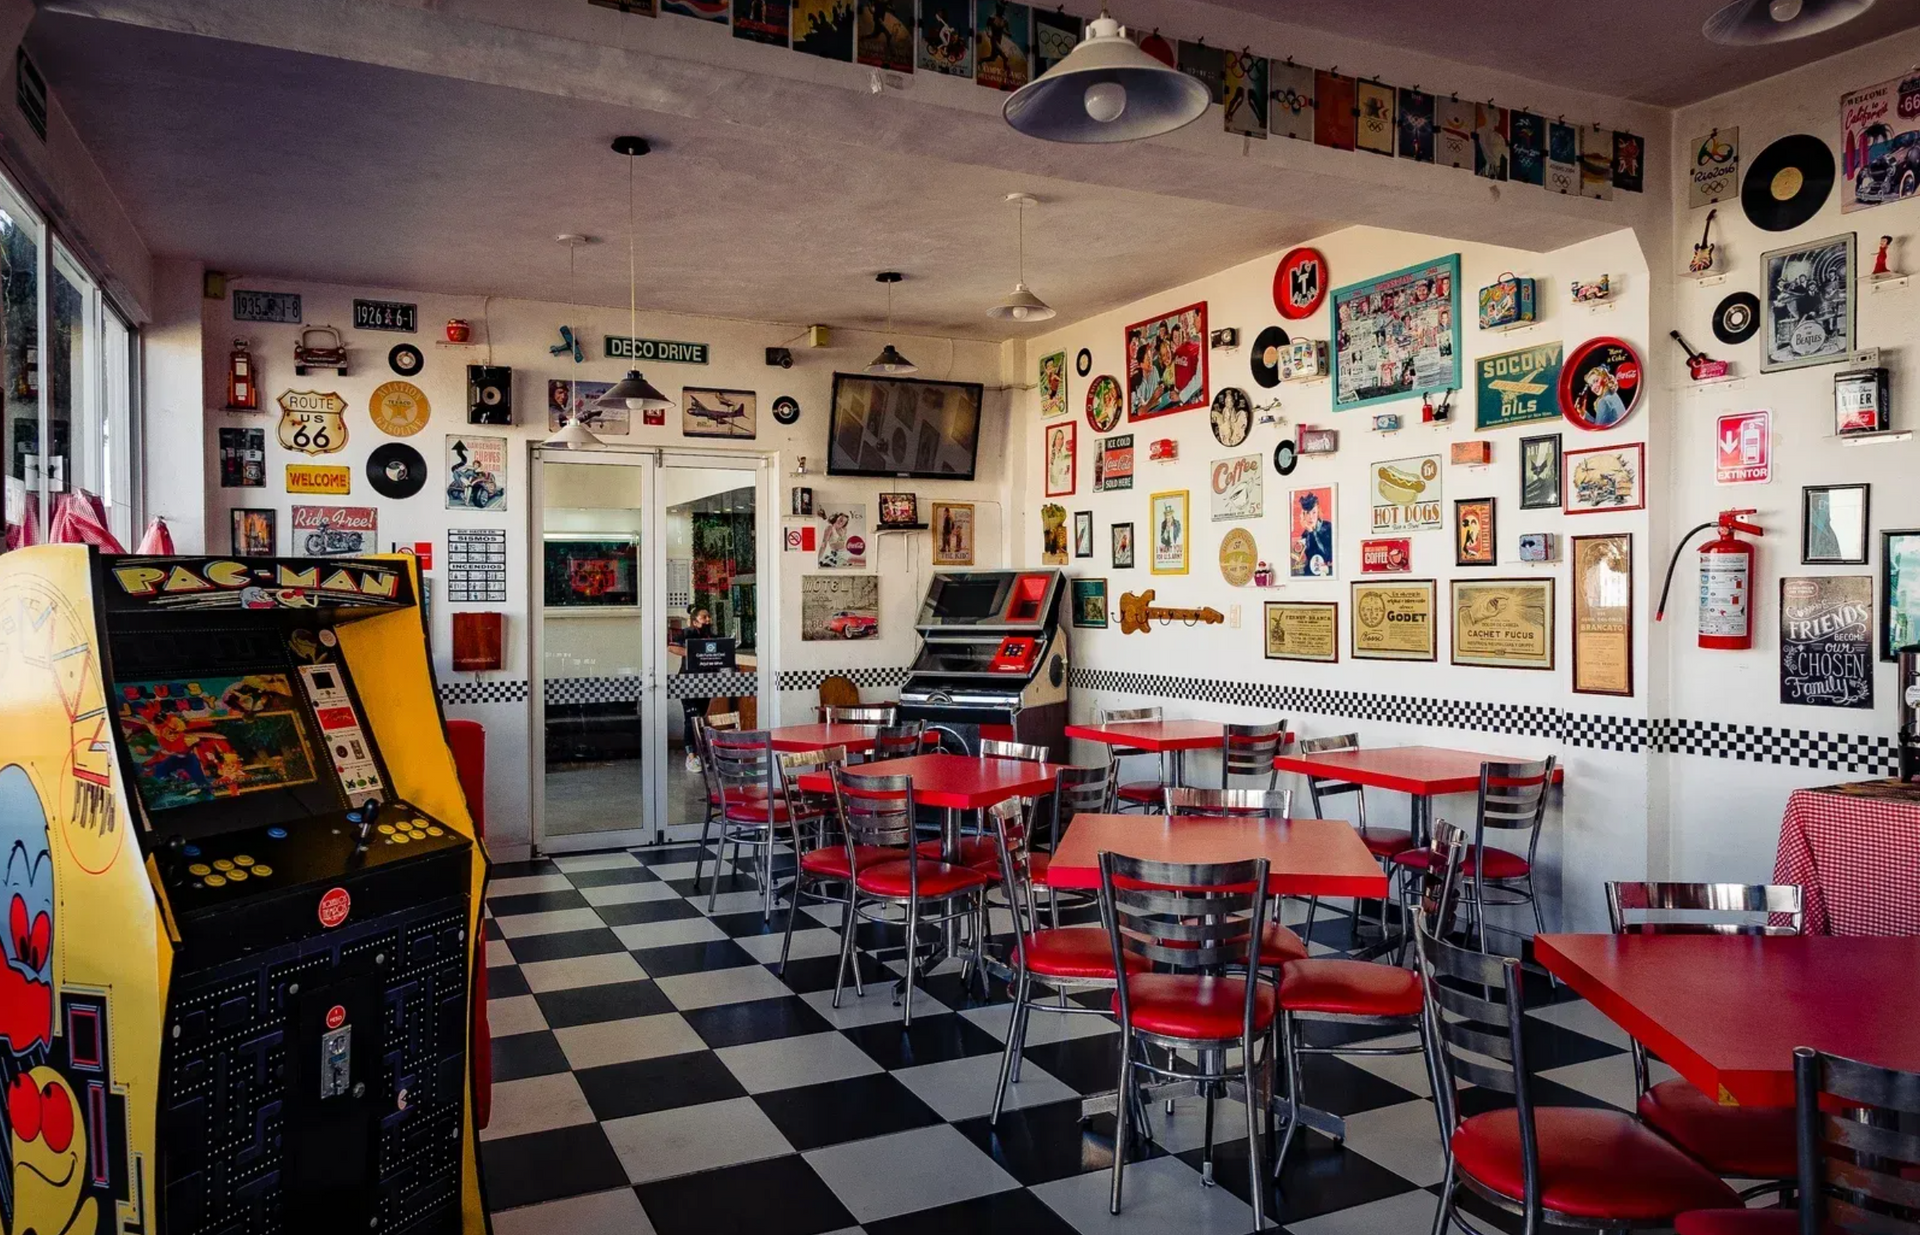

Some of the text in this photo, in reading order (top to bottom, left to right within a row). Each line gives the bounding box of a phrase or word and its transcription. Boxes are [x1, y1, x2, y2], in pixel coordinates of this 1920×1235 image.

[1846, 87, 1888, 106] WELCOME
[1845, 101, 1889, 130] California
[237, 297, 298, 318] 1935 1-8
[357, 305, 413, 328] 1926 6-1
[1795, 333, 1823, 346] BEATLES
[611, 339, 702, 362] DECO DRIVE
[1483, 349, 1561, 379] SOCONY
[378, 381, 425, 401] AVIATION
[1841, 393, 1872, 407] DINER
[289, 396, 334, 410] ROUTE
[1500, 399, 1537, 417] OILS
[300, 414, 324, 423] US
[375, 416, 426, 437] GASOLINE
[293, 425, 331, 448] 66
[1107, 436, 1131, 448] ICE COLD
[289, 472, 347, 488] WELCOME
[1105, 477, 1132, 489] SOLD HERE
[1212, 458, 1258, 494] Coffee
[1718, 468, 1768, 480] EXTINTOR
[295, 508, 373, 528] Ride Free!
[849, 510, 863, 520] Yes
[1373, 503, 1440, 525] HOT DOGS
[1364, 551, 1388, 564] COFFEE
[112, 559, 399, 598] PAC-MAN
[802, 579, 849, 593] MOTEL
[1387, 610, 1427, 622] GODET
[1788, 603, 1869, 640] FRIENDS
[1467, 630, 1535, 640] CACHET FUCUS
[1580, 623, 1624, 632] BRANCATO
[1834, 633, 1866, 642] BECOME
[1824, 642, 1855, 653] our
[1797, 652, 1864, 678] CHOSEN
[1784, 675, 1849, 703] Family
